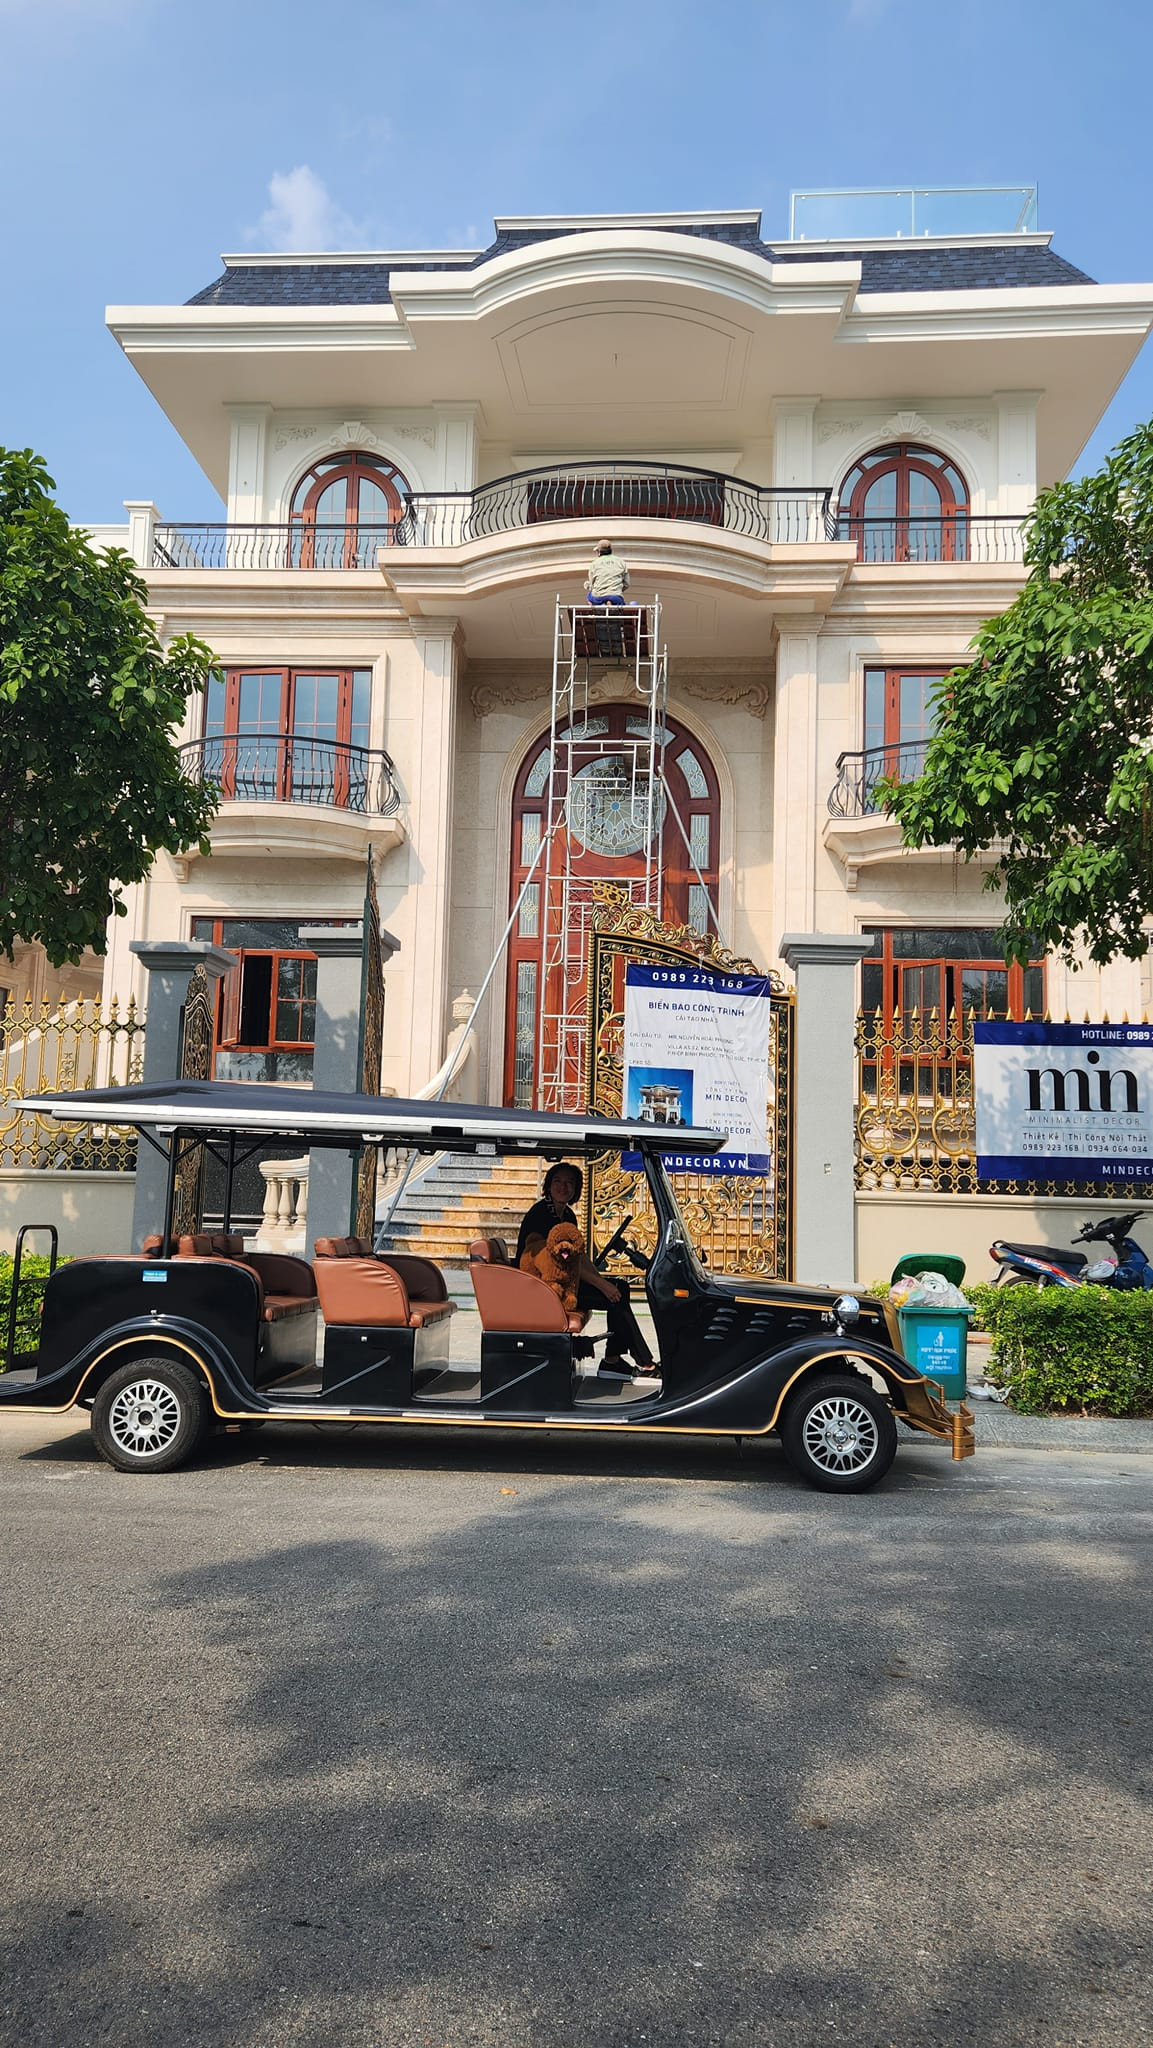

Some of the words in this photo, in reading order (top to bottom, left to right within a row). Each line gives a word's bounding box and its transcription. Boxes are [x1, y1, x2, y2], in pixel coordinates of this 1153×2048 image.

[652, 971, 686, 983] 0989
[692, 974, 714, 986] 223
[720, 978, 744, 990] 168
[1081, 1029, 1125, 1040] HOTLINE:
[1126, 1031, 1150, 1041] 0989
[1024, 1050, 1144, 1113] min
[1028, 1116, 1096, 1124] MINIMALIST
[1103, 1117, 1140, 1126] DECOR
[724, 1126, 751, 1135] DECOR
[1068, 1133, 1082, 1141] Thi
[1022, 1143, 1044, 1151] 0989
[1112, 1145, 1128, 1153] 064
[664, 1156, 746, 1169] NDECOR.VN
